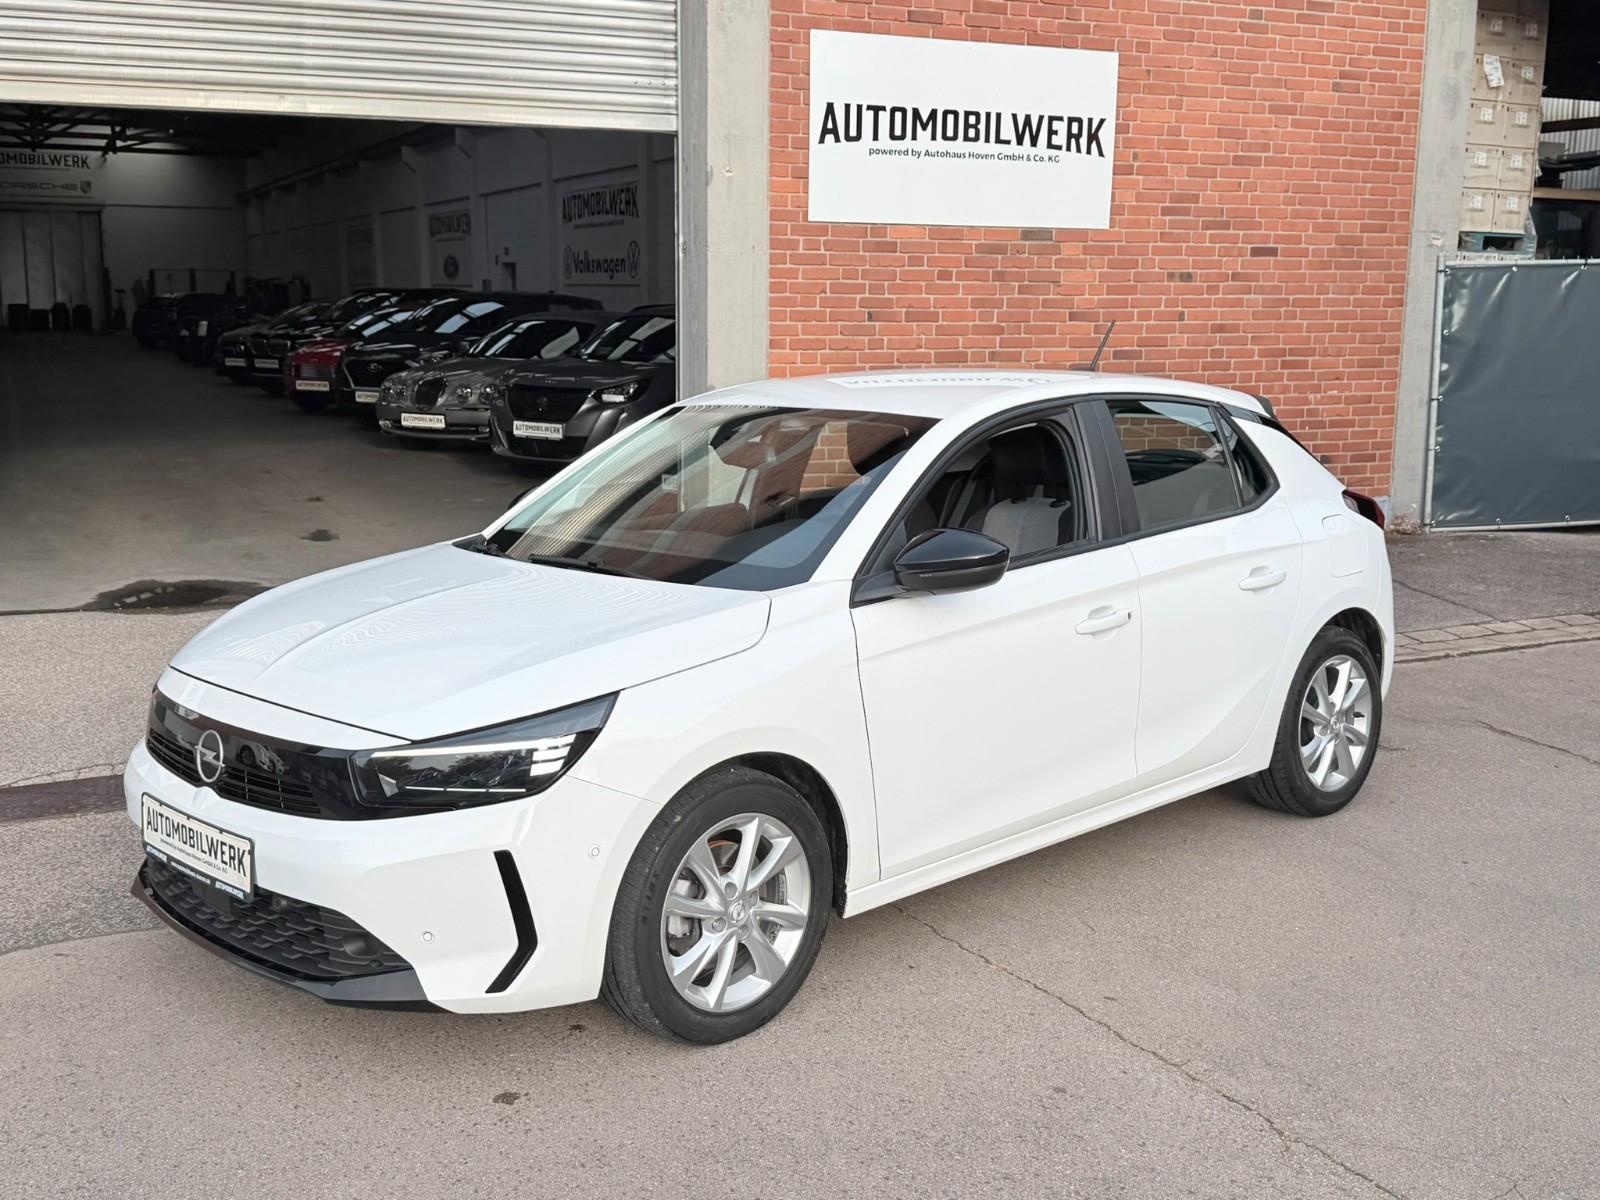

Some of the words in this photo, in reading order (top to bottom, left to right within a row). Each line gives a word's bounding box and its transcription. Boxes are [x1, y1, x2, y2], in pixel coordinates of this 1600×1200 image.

[818, 101, 1107, 158] AUTOMOBILWERK
[868, 147, 909, 156] powered
[911, 147, 922, 159] by
[923, 149, 967, 159] Autohaus
[968, 151, 995, 160] Hoven
[997, 152, 1024, 162] GmbH
[1048, 154, 1060, 163] KG
[562, 186, 640, 224] AUTOMOBILWERK
[573, 249, 626, 279] Volkswagen
[515, 423, 561, 434] AUTOMOBILWERK
[146, 806, 247, 877] AUTOMOBILWERK
